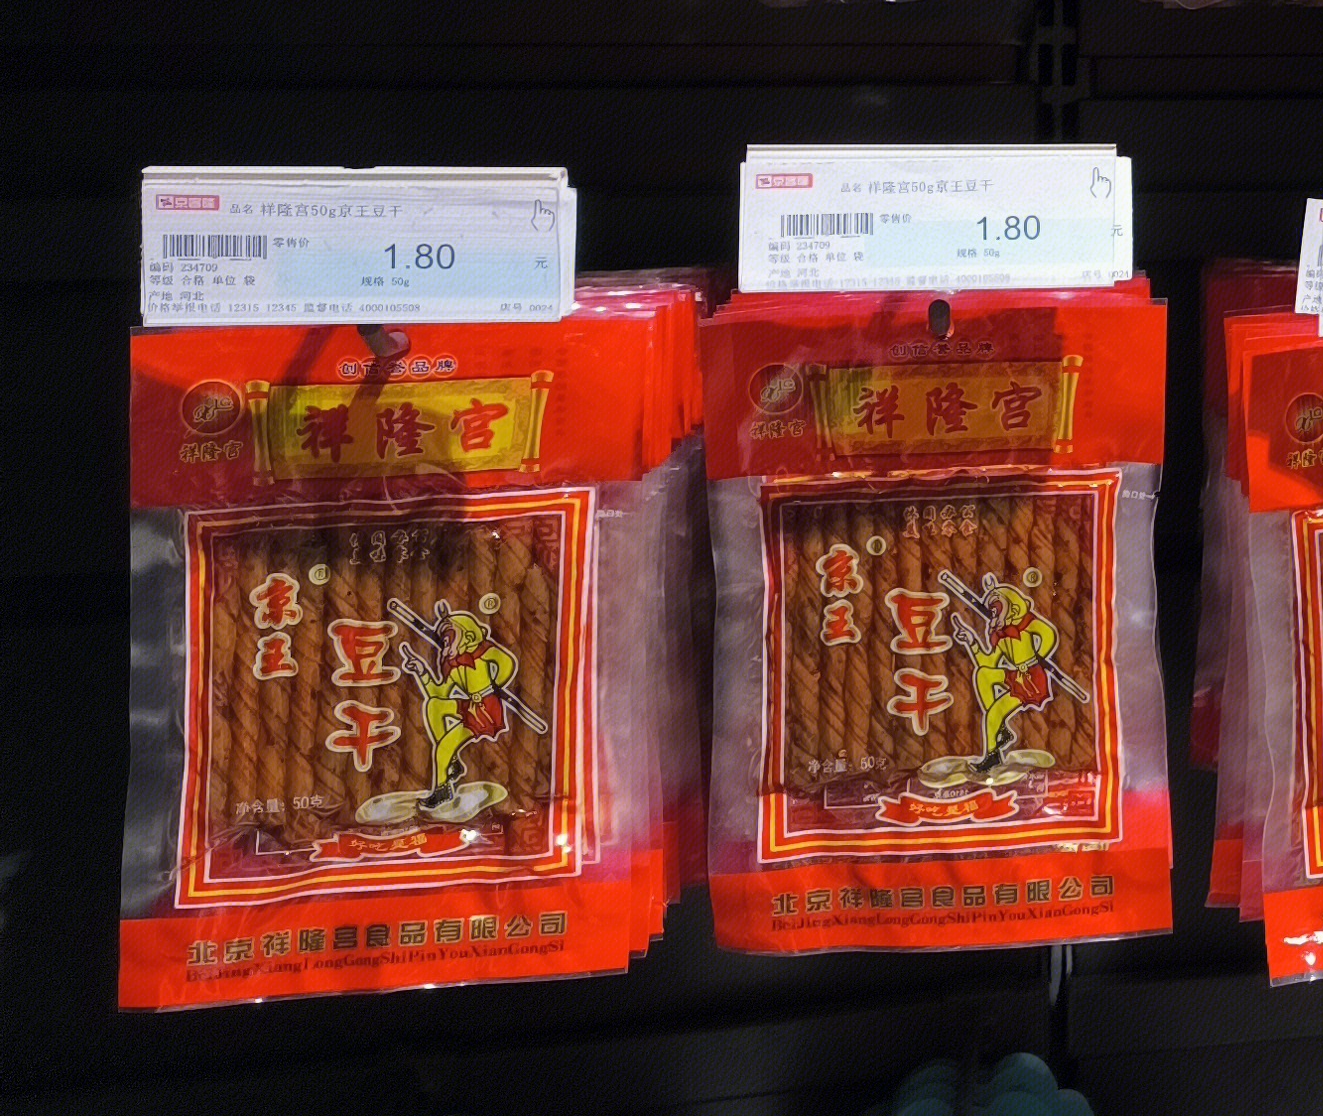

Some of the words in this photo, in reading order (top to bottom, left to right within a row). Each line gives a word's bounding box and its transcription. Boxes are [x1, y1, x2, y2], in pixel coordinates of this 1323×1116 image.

[976, 215, 1041, 241] 1.80
[383, 243, 456, 270] 1.80
[391, 276, 410, 288] 50g
[227, 303, 259, 312] 12315
[265, 303, 297, 312] 12345
[298, 397, 509, 464] 祥隆宫
[854, 380, 1043, 439] 祥隆宫
[885, 588, 953, 736] 豆干
[327, 621, 400, 771] 豆干
[771, 874, 1116, 916] 北京祥隆宫食品有限公司
[188, 910, 568, 966] 北京祥隆宫食品有限公司
